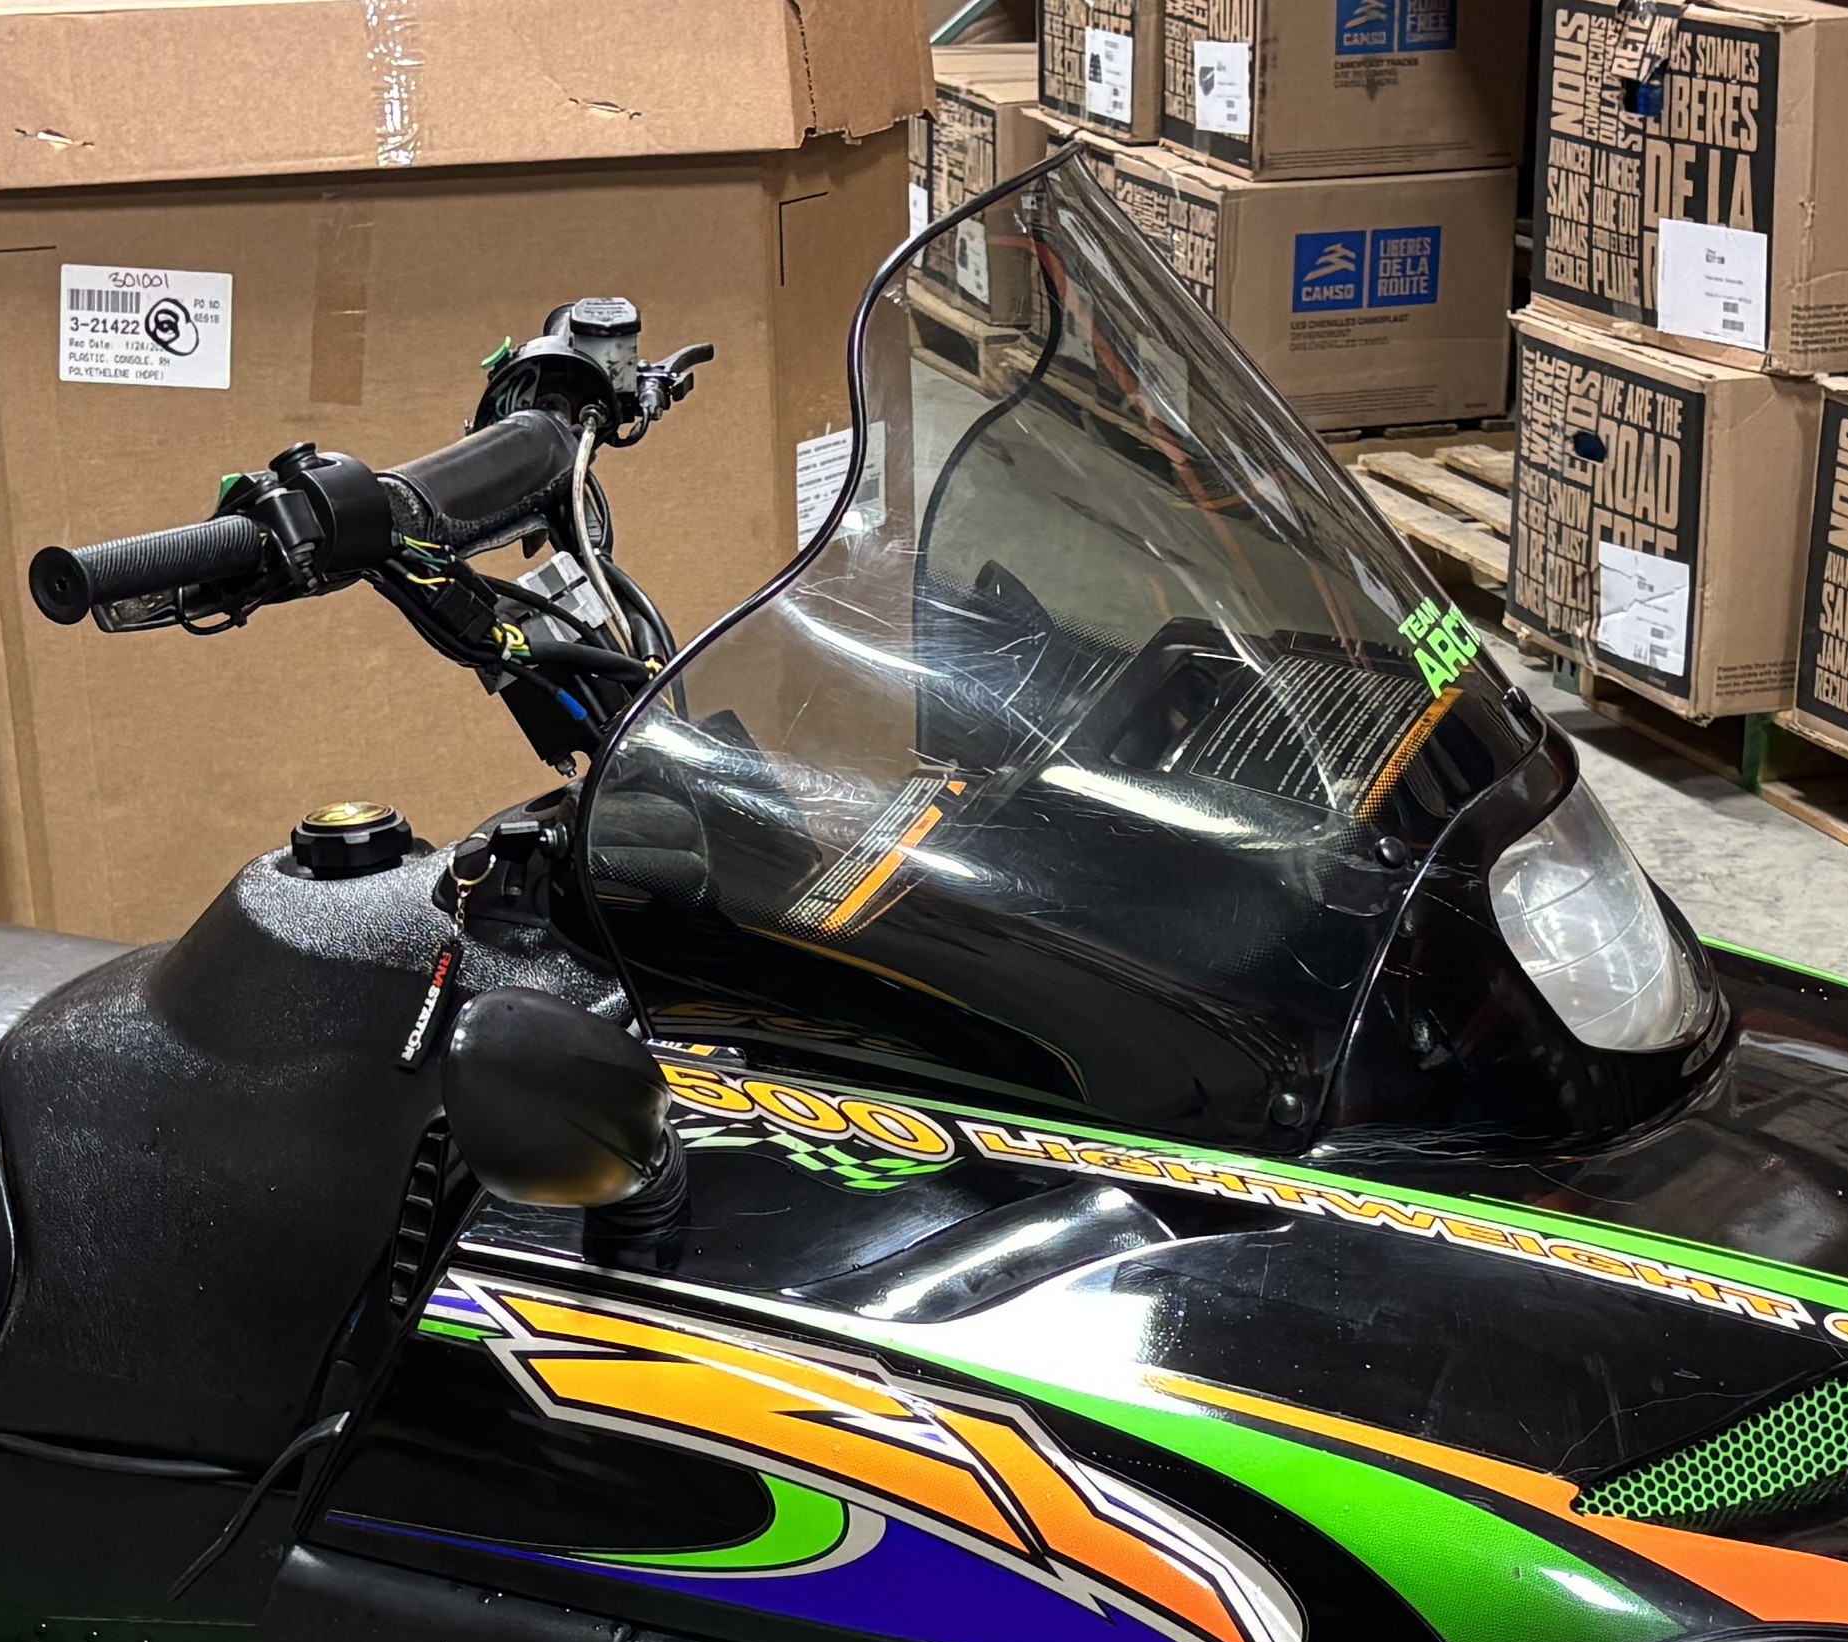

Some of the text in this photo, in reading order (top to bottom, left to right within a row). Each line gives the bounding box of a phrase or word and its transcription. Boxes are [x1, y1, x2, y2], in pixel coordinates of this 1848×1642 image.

[1406, 12, 1449, 33] FREE
[1550, 9, 1590, 137] NOUS
[1695, 34, 1760, 84] SOMMES
[1546, 167, 1591, 225] SANS
[108, 272, 170, 289] 301001
[1302, 284, 1355, 302] CAMSO
[1377, 277, 1429, 297] ROUTE
[1379, 257, 1430, 277] DE LA
[1592, 247, 1640, 307] PLUIE
[69, 316, 141, 335] 3-21422
[1529, 350, 1556, 465] WHERE
[1601, 374, 1683, 440] WE ARE THE
[1593, 416, 1681, 530] ROAD
[1549, 478, 1591, 532] SNOW
[1398, 597, 1441, 645] TEAM
[659, 1062, 955, 1161] 500
[957, 1121, 1815, 1330] LIGHTWEIGHT
